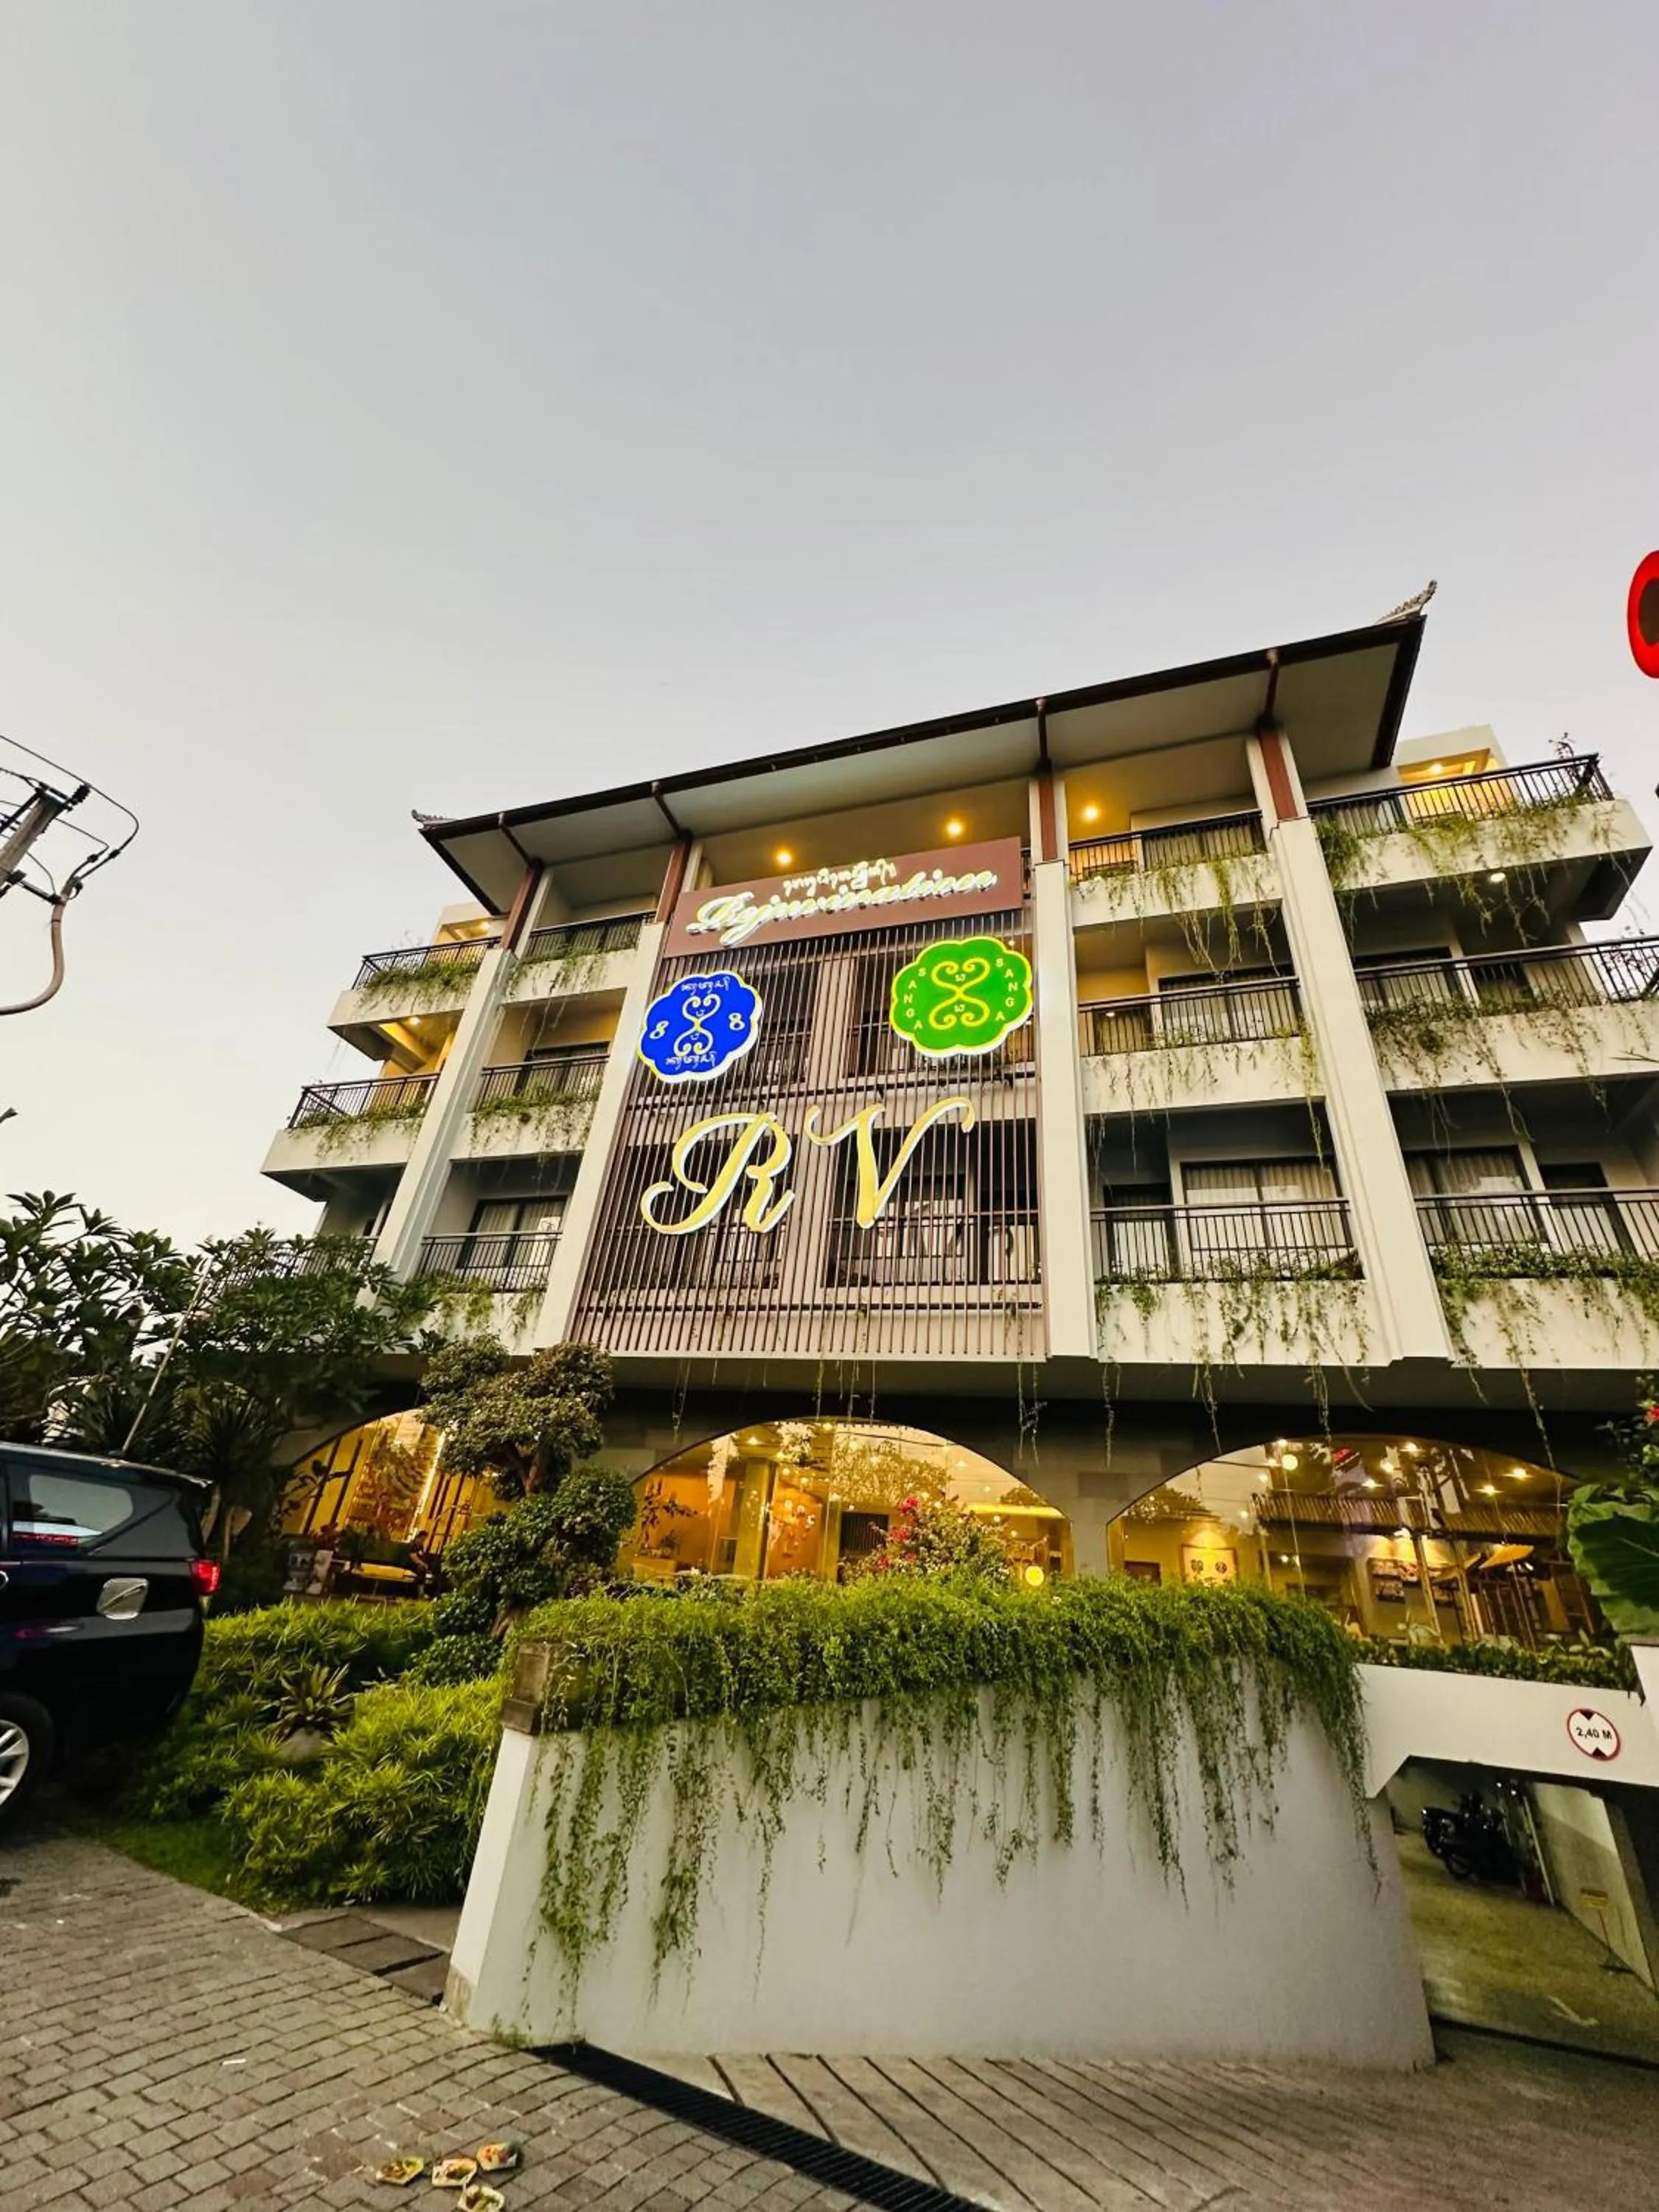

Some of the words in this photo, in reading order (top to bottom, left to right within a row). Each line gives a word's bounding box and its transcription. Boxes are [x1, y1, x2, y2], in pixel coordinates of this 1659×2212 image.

[650, 1020, 669, 1040] 8
[728, 1012, 745, 1032] 8
[1576, 1726, 1599, 1739] 2,40
